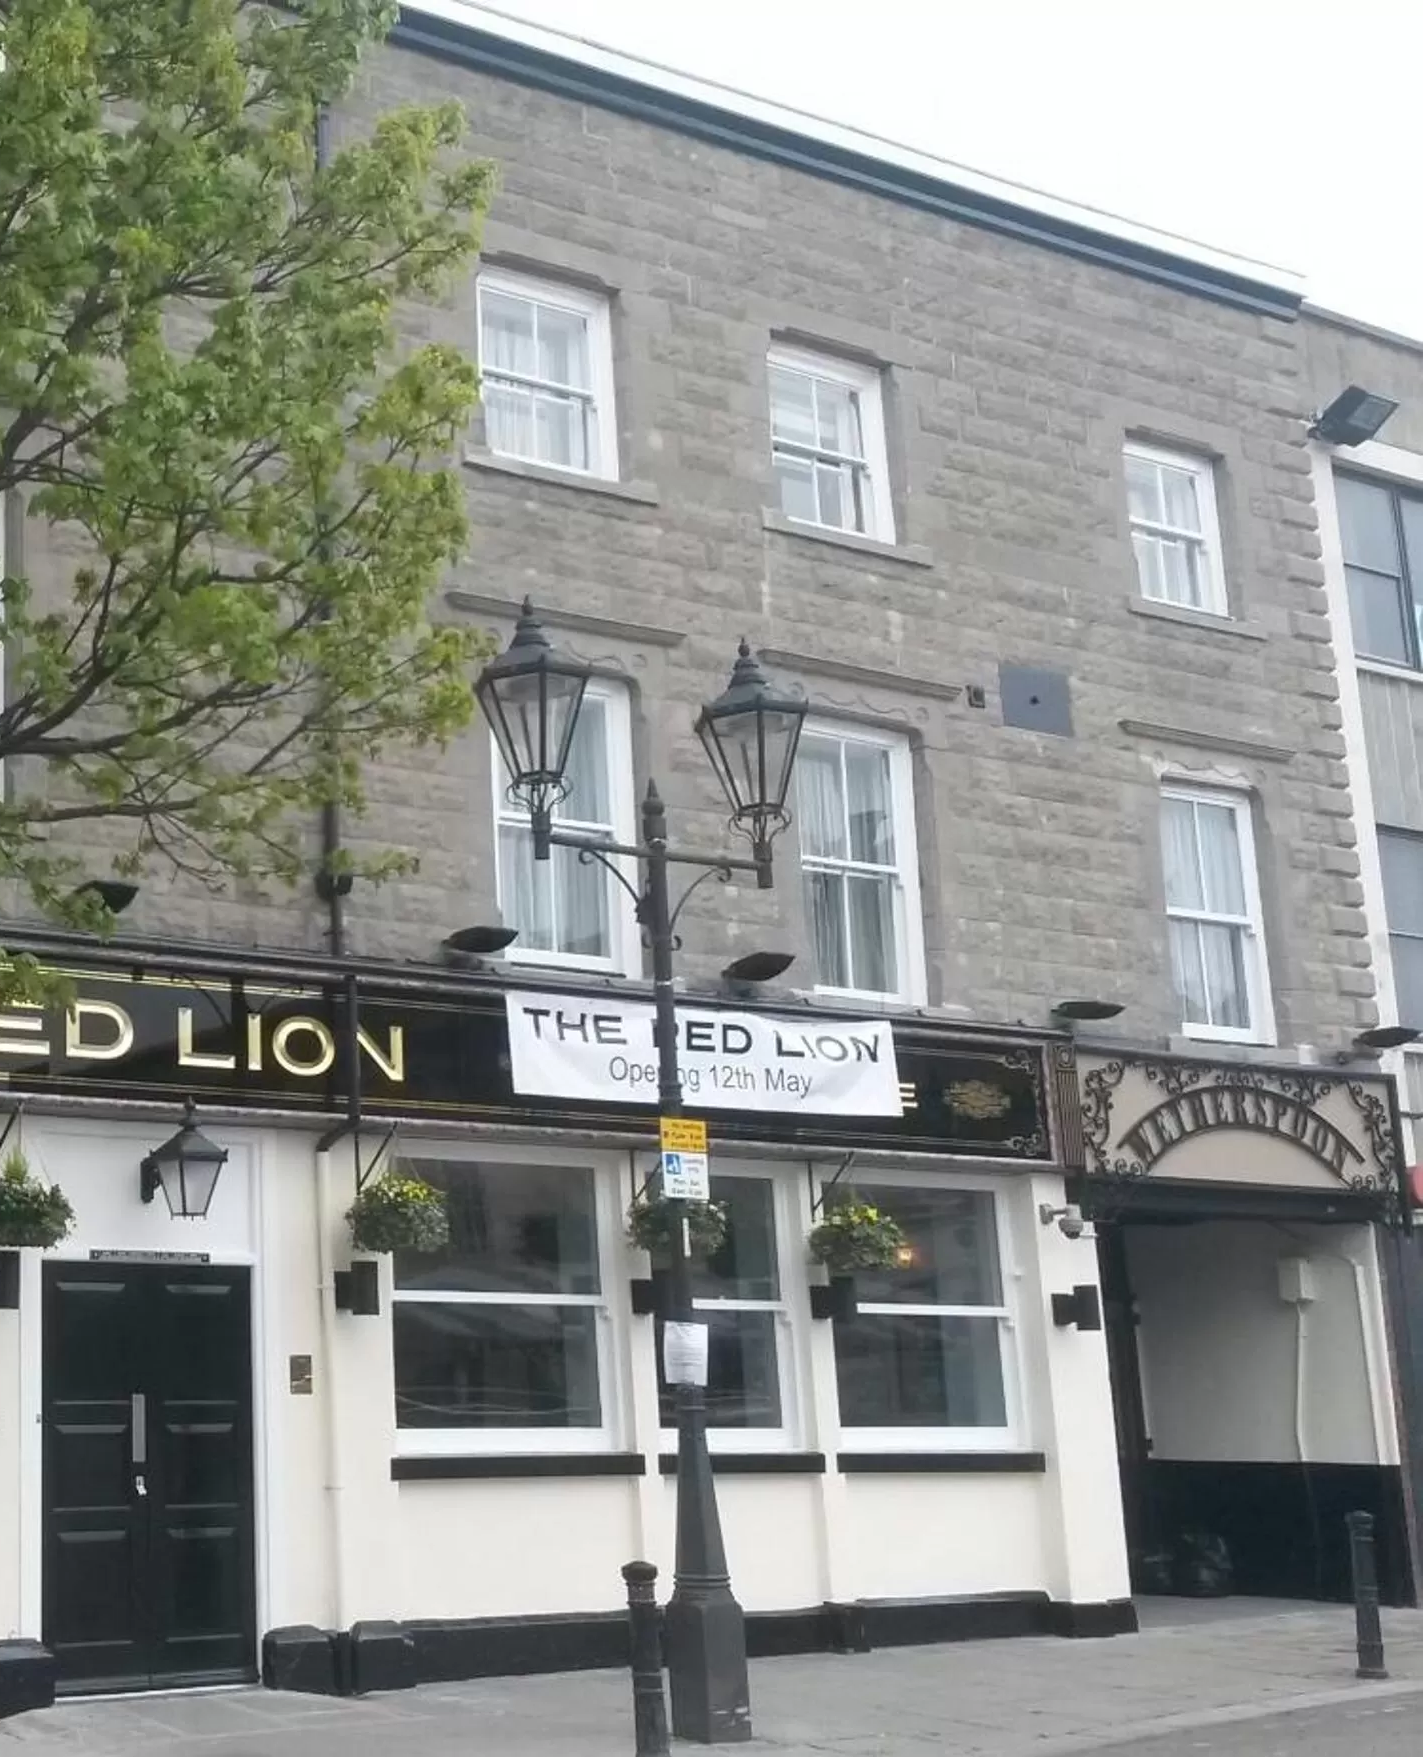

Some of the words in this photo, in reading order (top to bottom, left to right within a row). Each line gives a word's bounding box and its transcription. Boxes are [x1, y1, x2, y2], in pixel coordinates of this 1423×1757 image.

[177, 1006, 405, 1082] LION
[522, 1007, 627, 1045] THE
[773, 1029, 879, 1063] LION
[609, 1056, 701, 1093] Openg
[709, 1064, 756, 1091] 12th
[764, 1067, 813, 1100] May
[1126, 1090, 1349, 1176] WETHERSPOON
